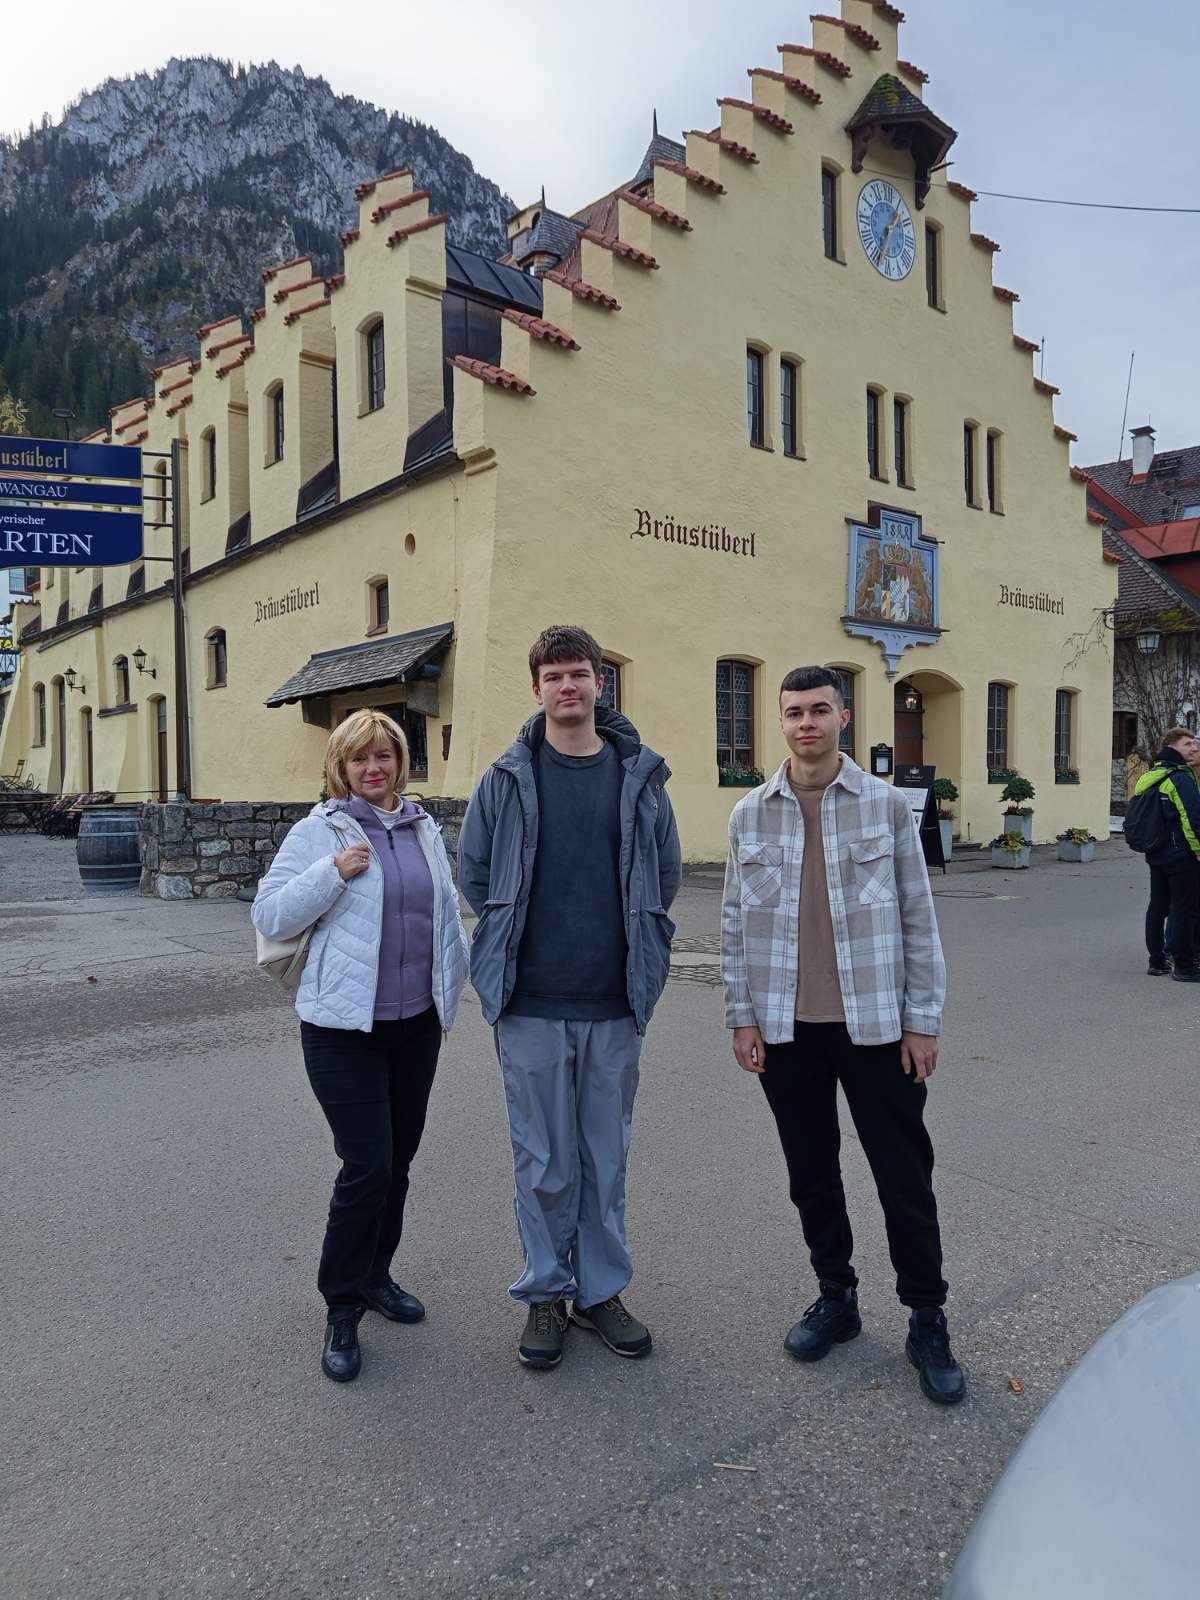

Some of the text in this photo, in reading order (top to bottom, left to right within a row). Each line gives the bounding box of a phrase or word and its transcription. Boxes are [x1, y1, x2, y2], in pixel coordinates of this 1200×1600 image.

[0, 530, 94, 555] RTEN
[630, 508, 756, 557] Bräustüberl
[253, 581, 320, 629] Bräustüberl
[997, 583, 1064, 615] Bräustüberl
